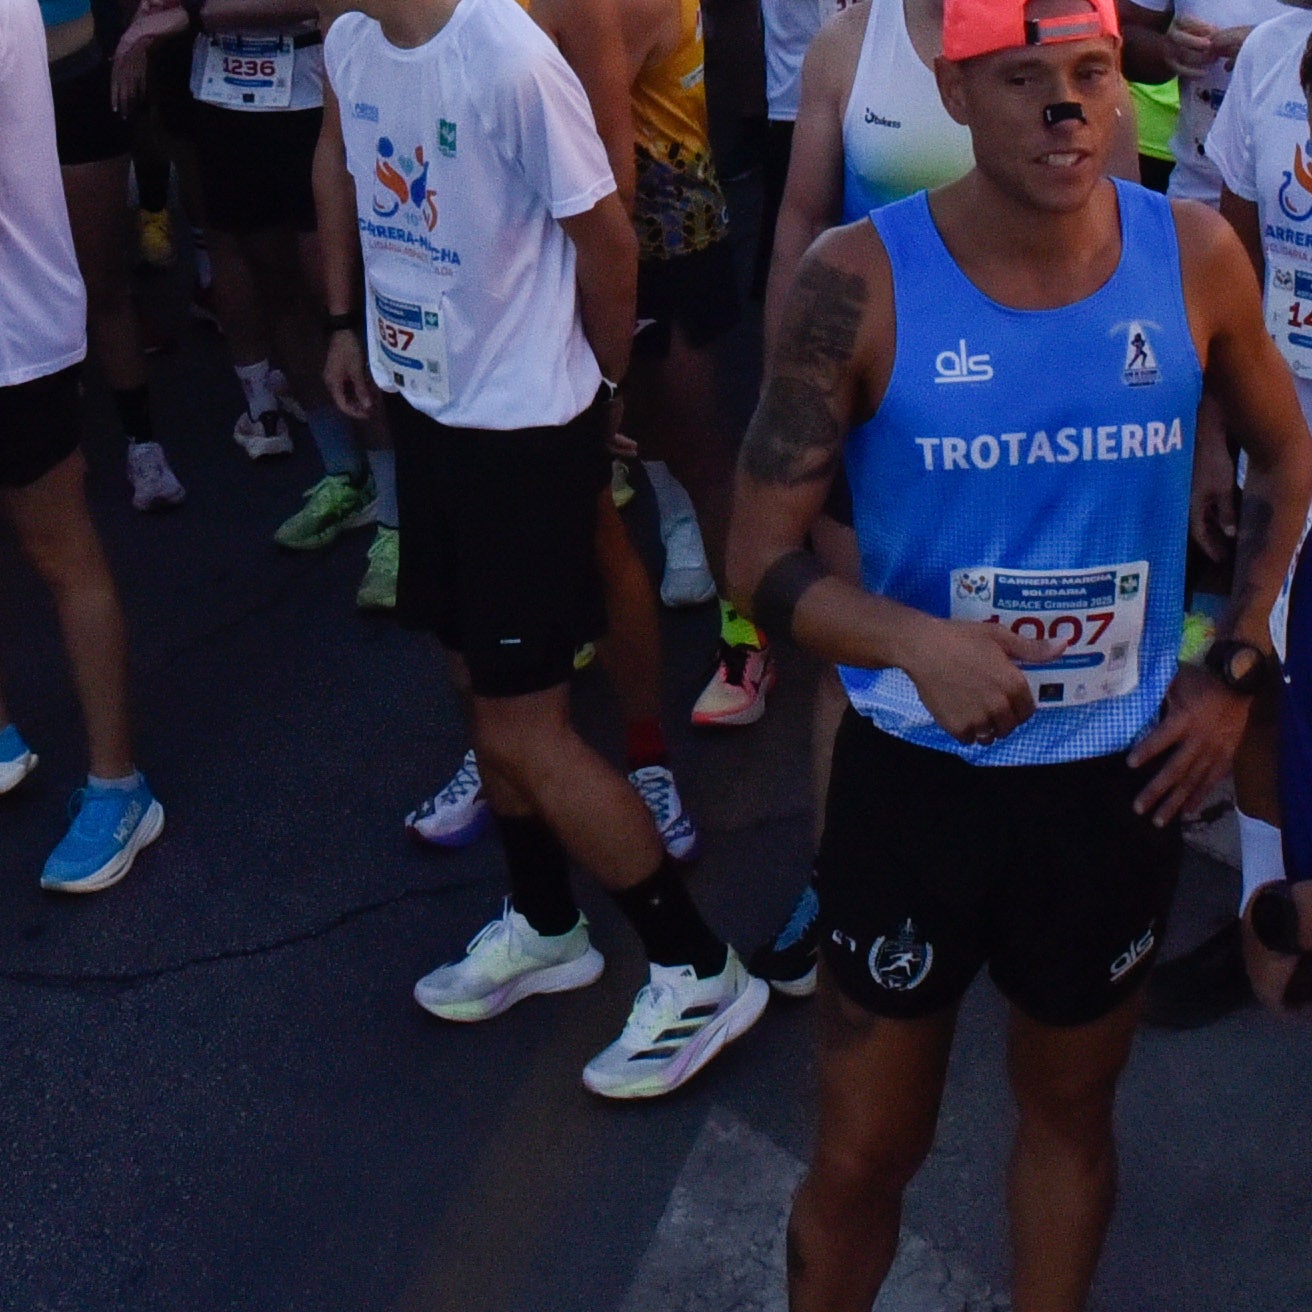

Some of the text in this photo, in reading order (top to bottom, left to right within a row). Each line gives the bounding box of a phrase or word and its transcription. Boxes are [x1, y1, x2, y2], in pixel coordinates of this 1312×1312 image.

[223, 57, 276, 77] 1236
[934, 338, 994, 384] als
[914, 418, 1183, 473] TROTASIERRA
[997, 595, 1113, 609] ASPACE Granada 2025
[1021, 587, 1087, 597] SOLIDARIA
